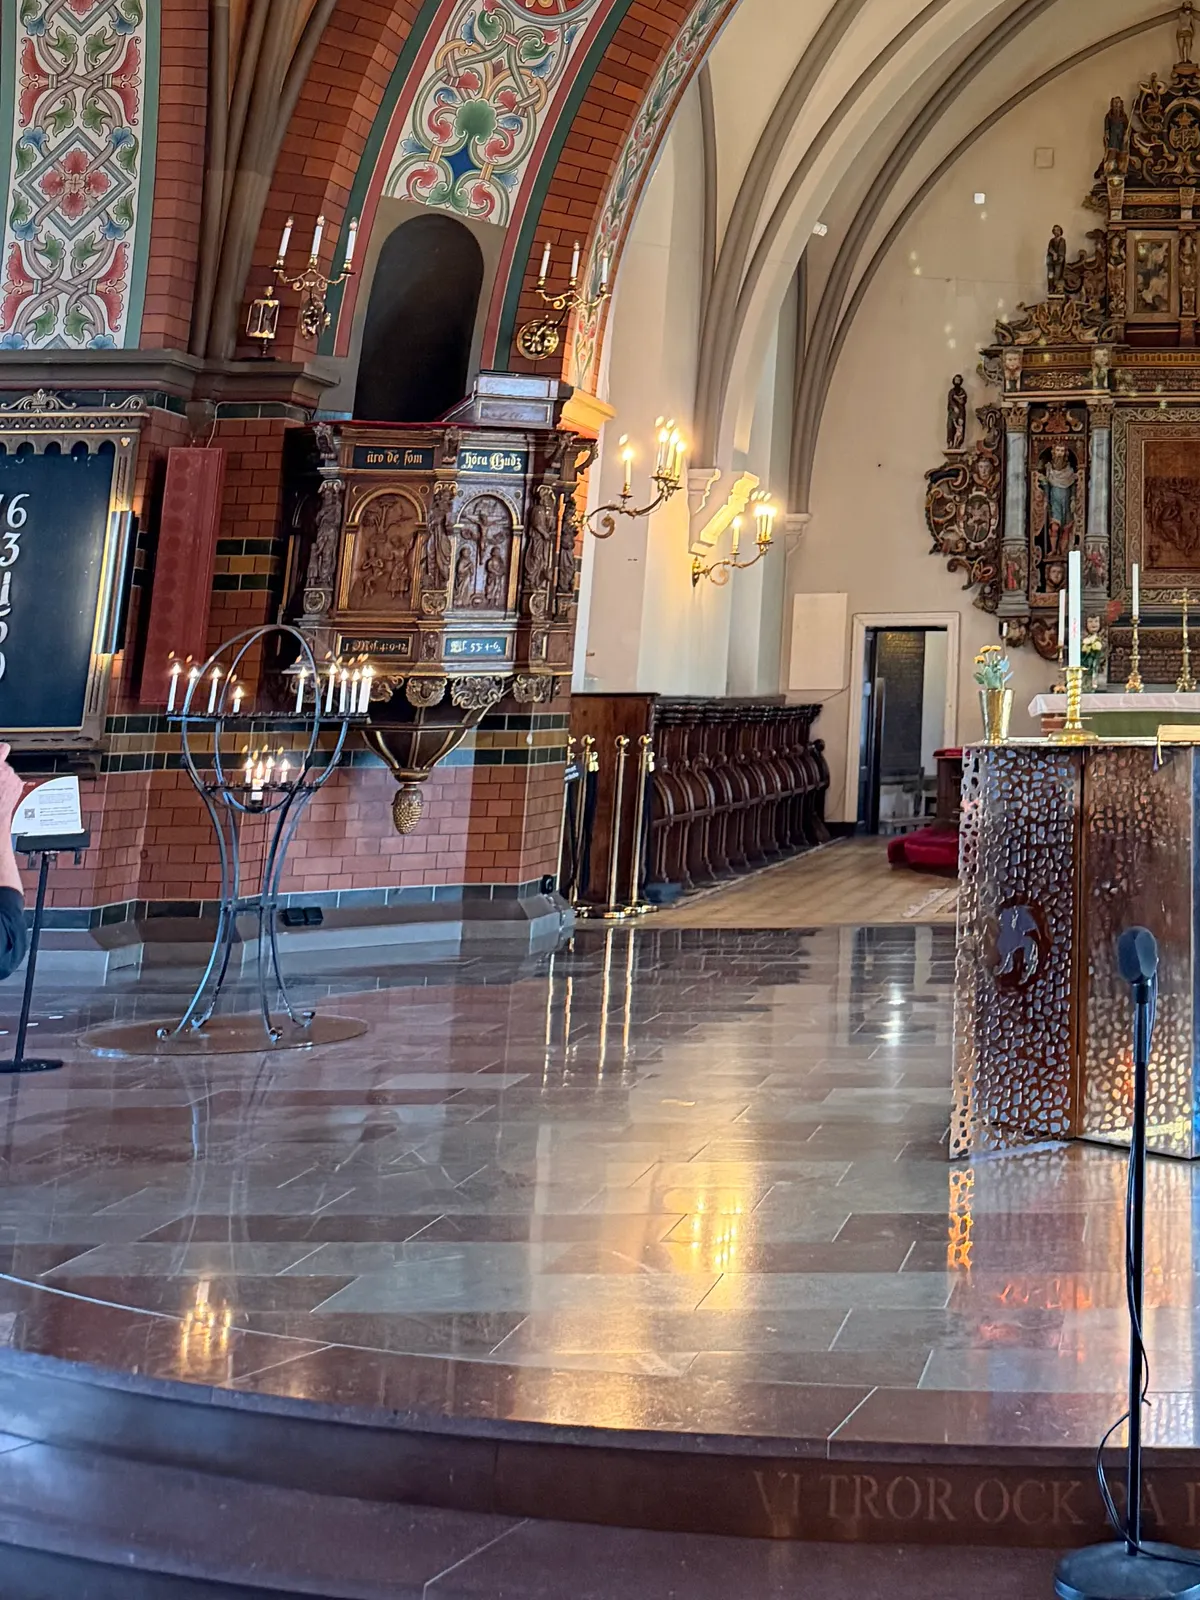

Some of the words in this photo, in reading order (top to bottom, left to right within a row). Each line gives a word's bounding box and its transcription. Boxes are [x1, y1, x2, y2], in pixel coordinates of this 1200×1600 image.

[752, 1471, 800, 1520] VI
[819, 1472, 958, 1522] TROR
[973, 1478, 1086, 1526] OCK
